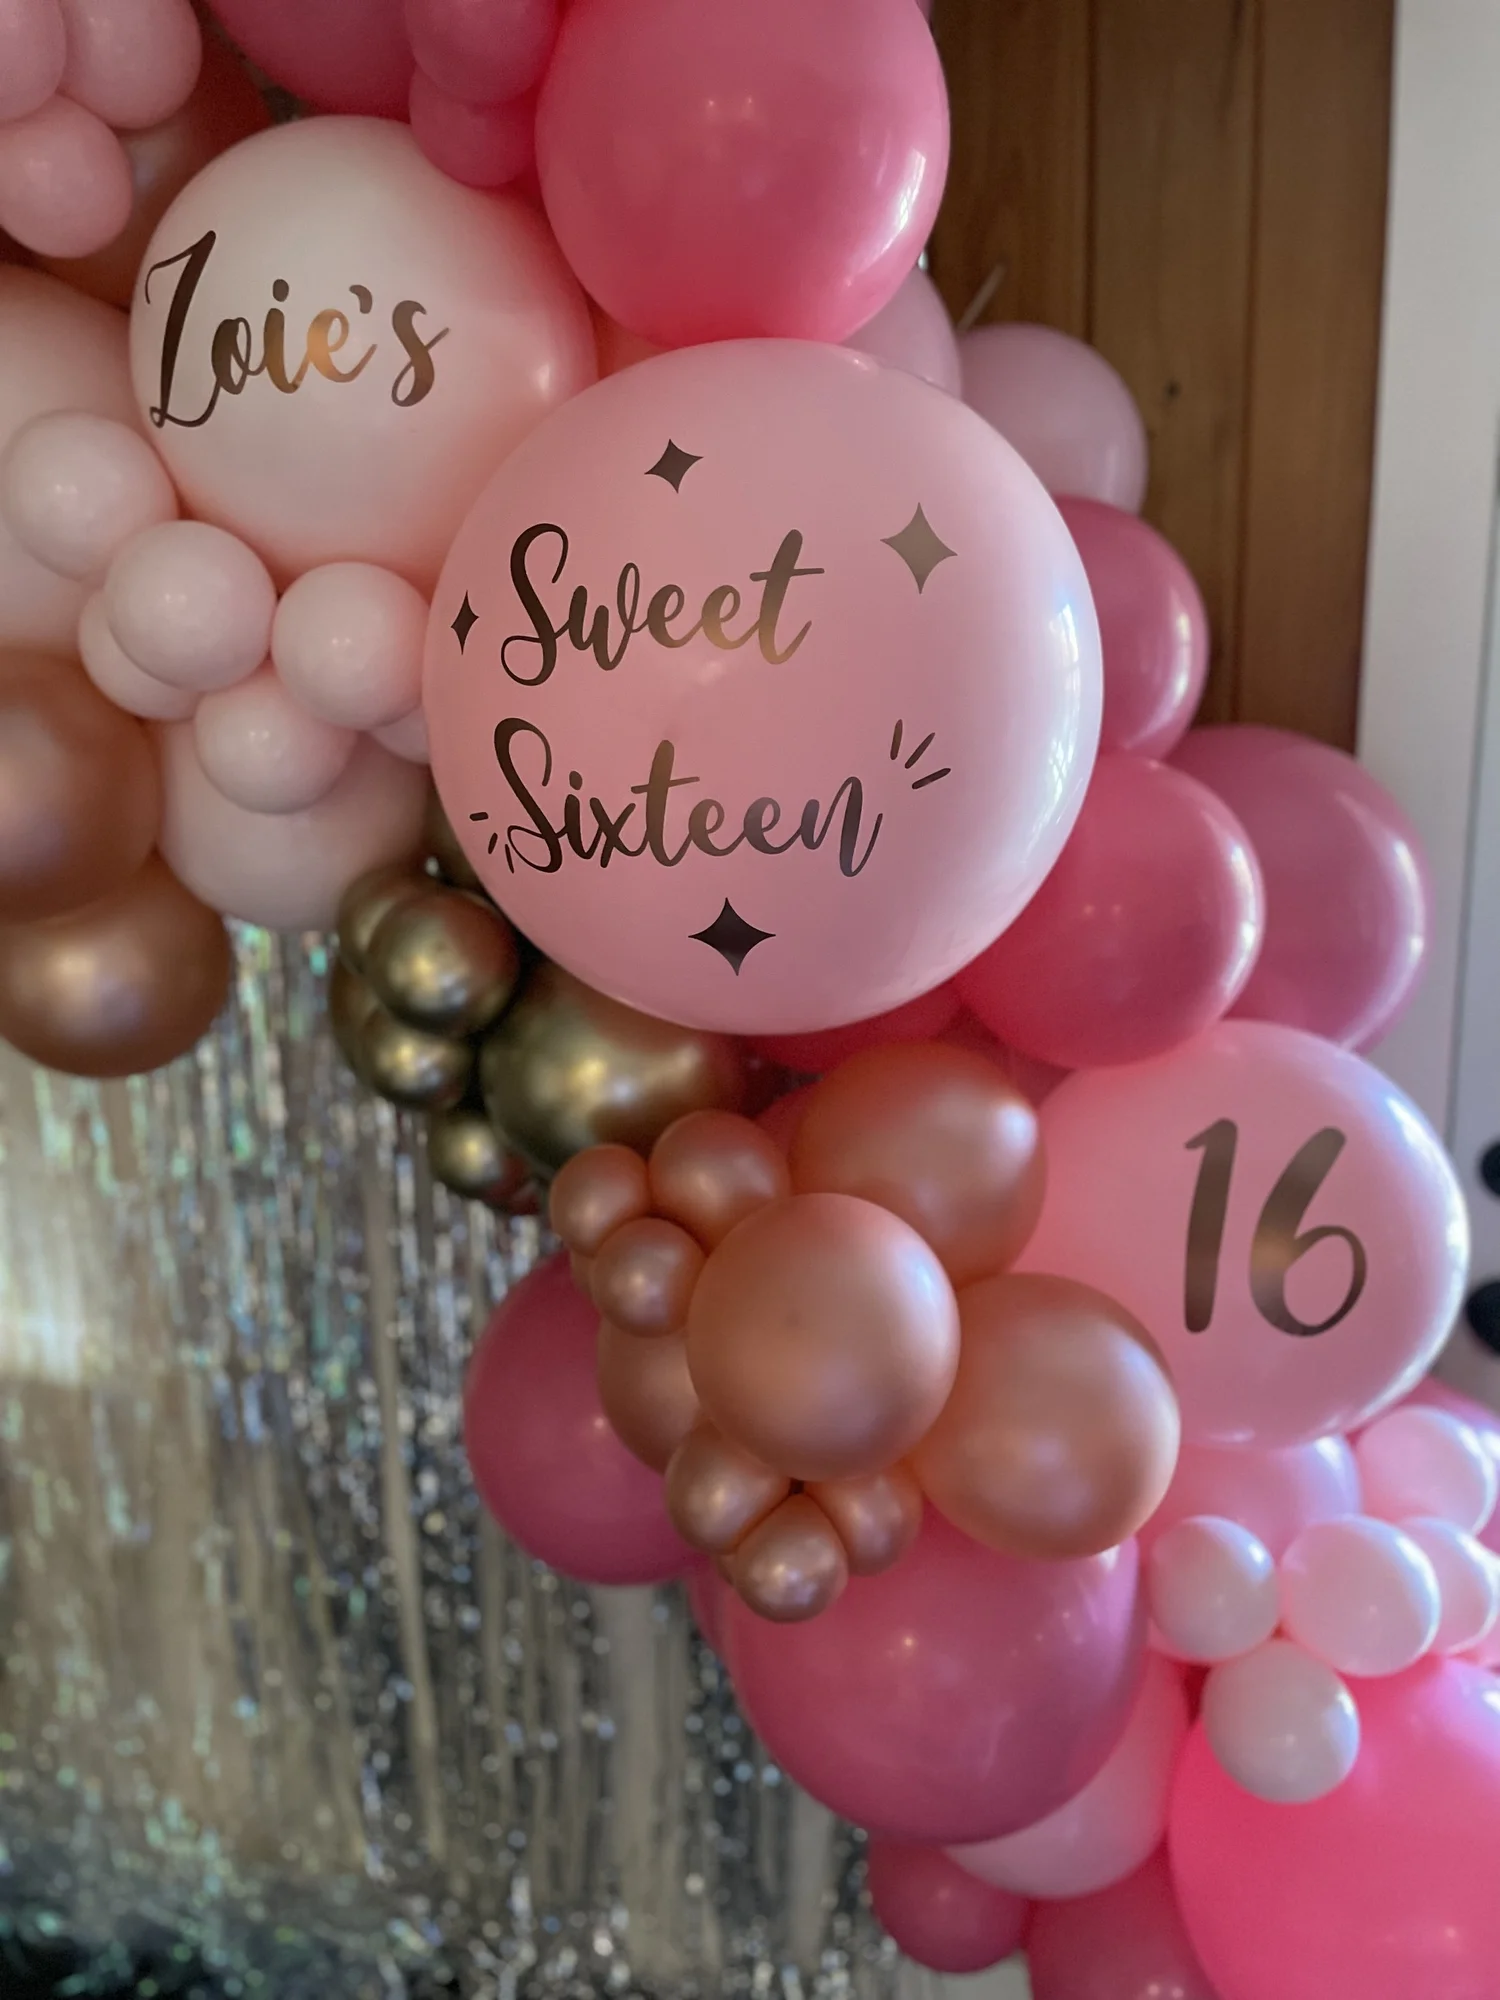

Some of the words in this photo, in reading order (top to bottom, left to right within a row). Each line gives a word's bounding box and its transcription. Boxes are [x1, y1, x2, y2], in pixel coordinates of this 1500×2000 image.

[144, 229, 451, 430] Zoie's
[499, 521, 827, 687] Sweet
[492, 716, 885, 878] Sixteen
[1183, 1117, 1369, 1339] 16
